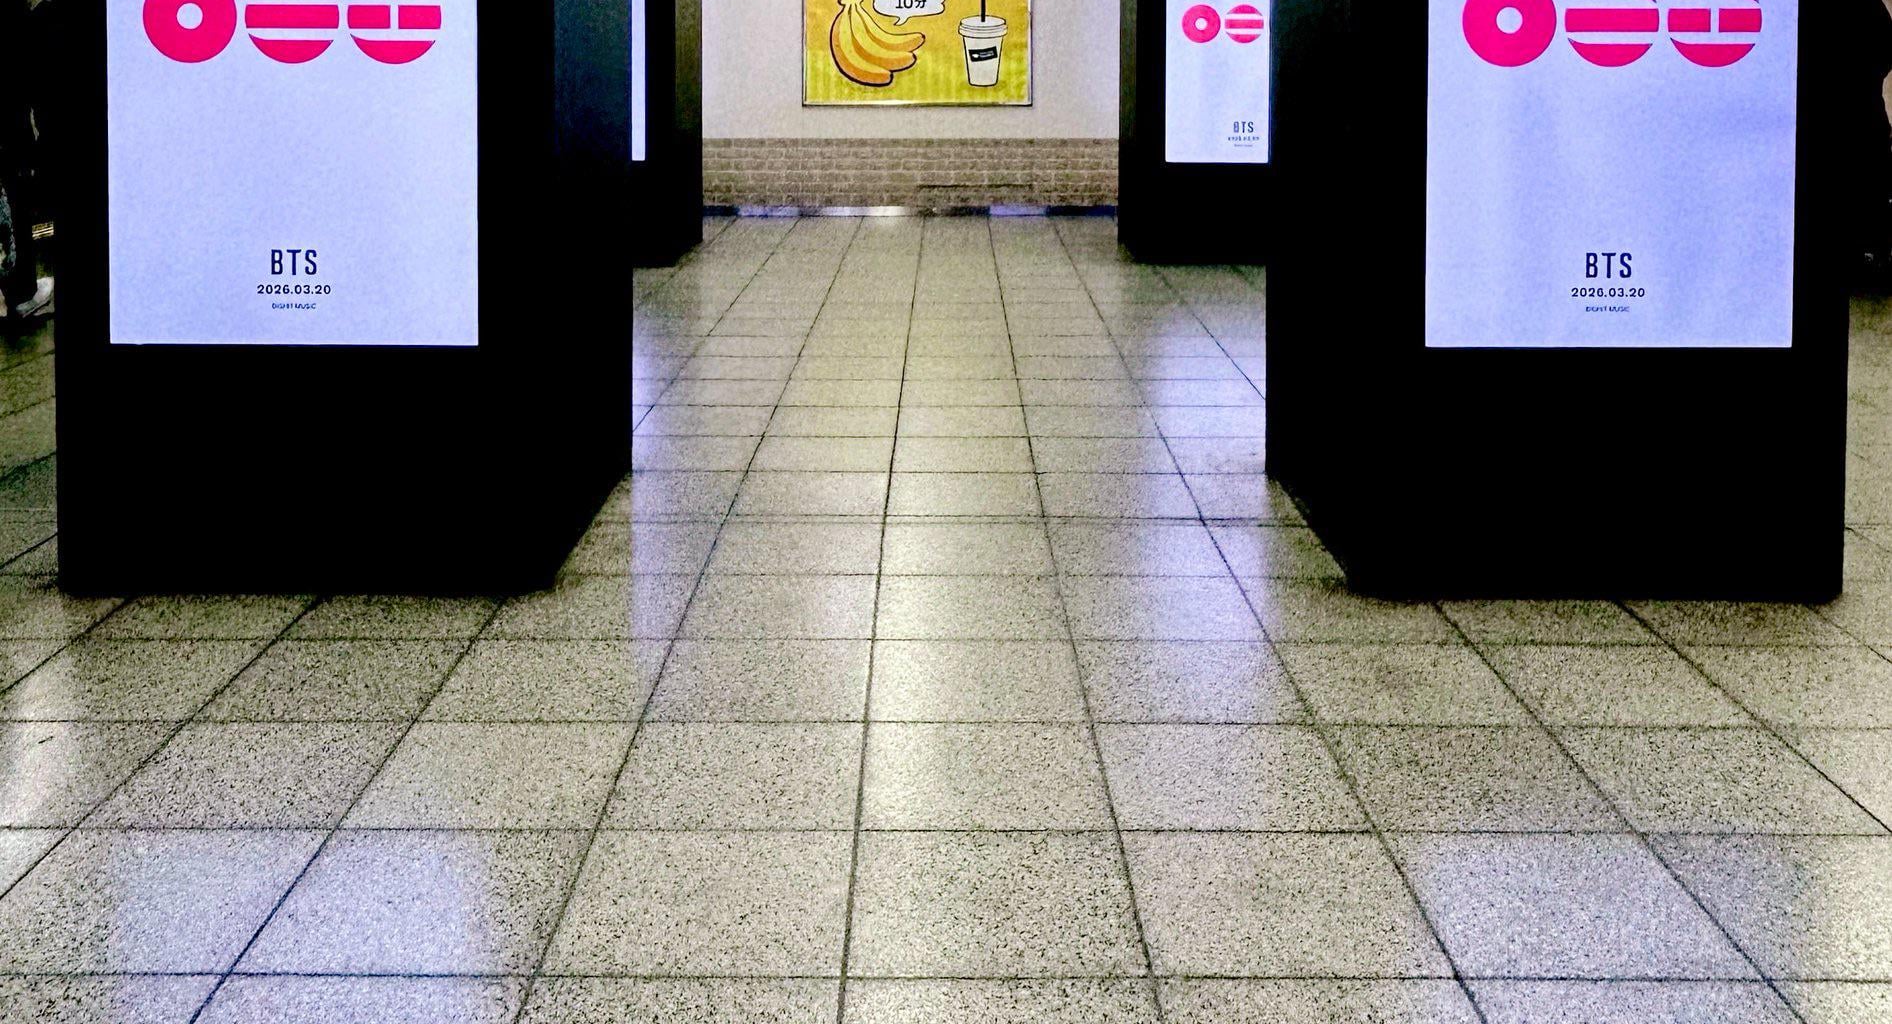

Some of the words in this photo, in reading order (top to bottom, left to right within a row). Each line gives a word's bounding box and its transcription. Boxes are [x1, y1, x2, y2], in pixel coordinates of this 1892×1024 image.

[1233, 121, 1254, 133] BTS
[271, 249, 317, 276] BTS
[1585, 252, 1632, 279] BTS
[256, 284, 332, 295] 2026.03.20
[1570, 287, 1645, 298] 2026.03.20
